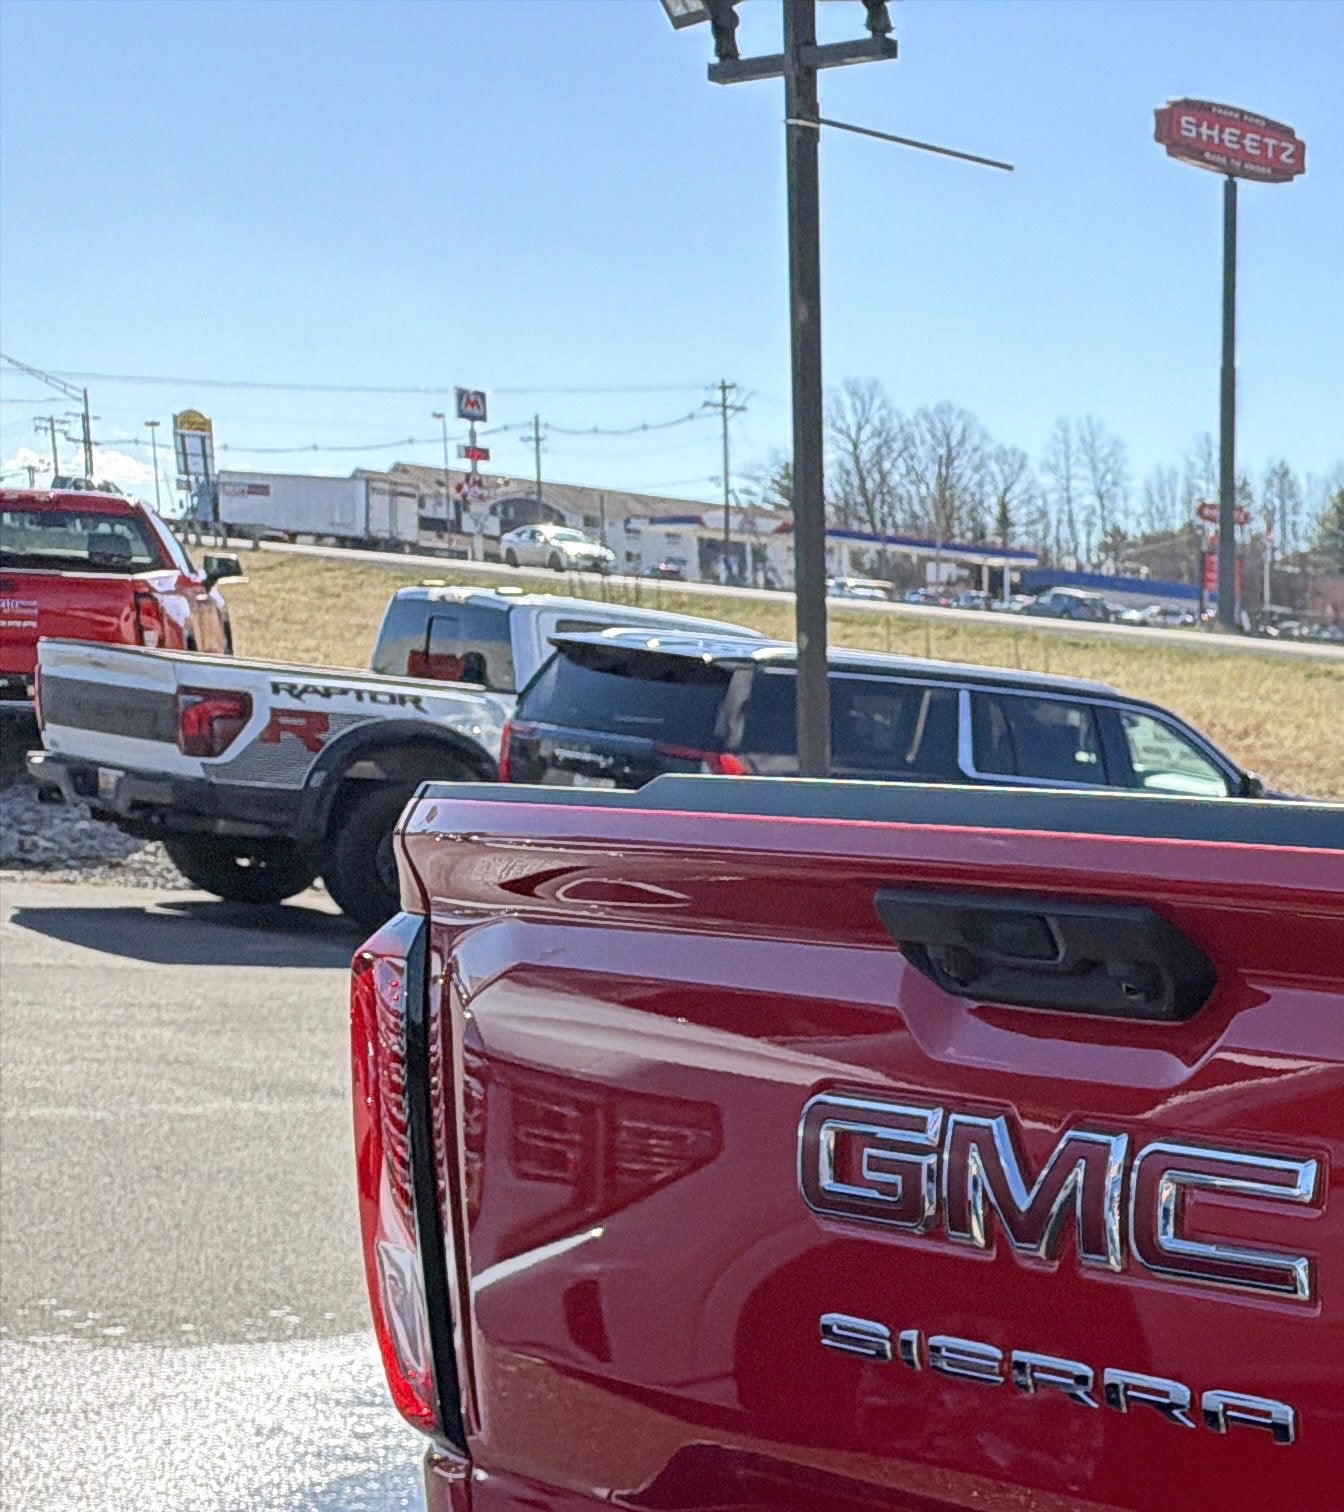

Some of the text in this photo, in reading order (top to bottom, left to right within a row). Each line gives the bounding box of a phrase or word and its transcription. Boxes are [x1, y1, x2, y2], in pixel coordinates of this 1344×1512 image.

[1180, 115, 1297, 165] SHEETZ
[270, 681, 430, 714] RAPTOR
[261, 707, 331, 754] R
[797, 1089, 1319, 1302] GMC
[819, 1311, 1296, 1446] SIERRA
